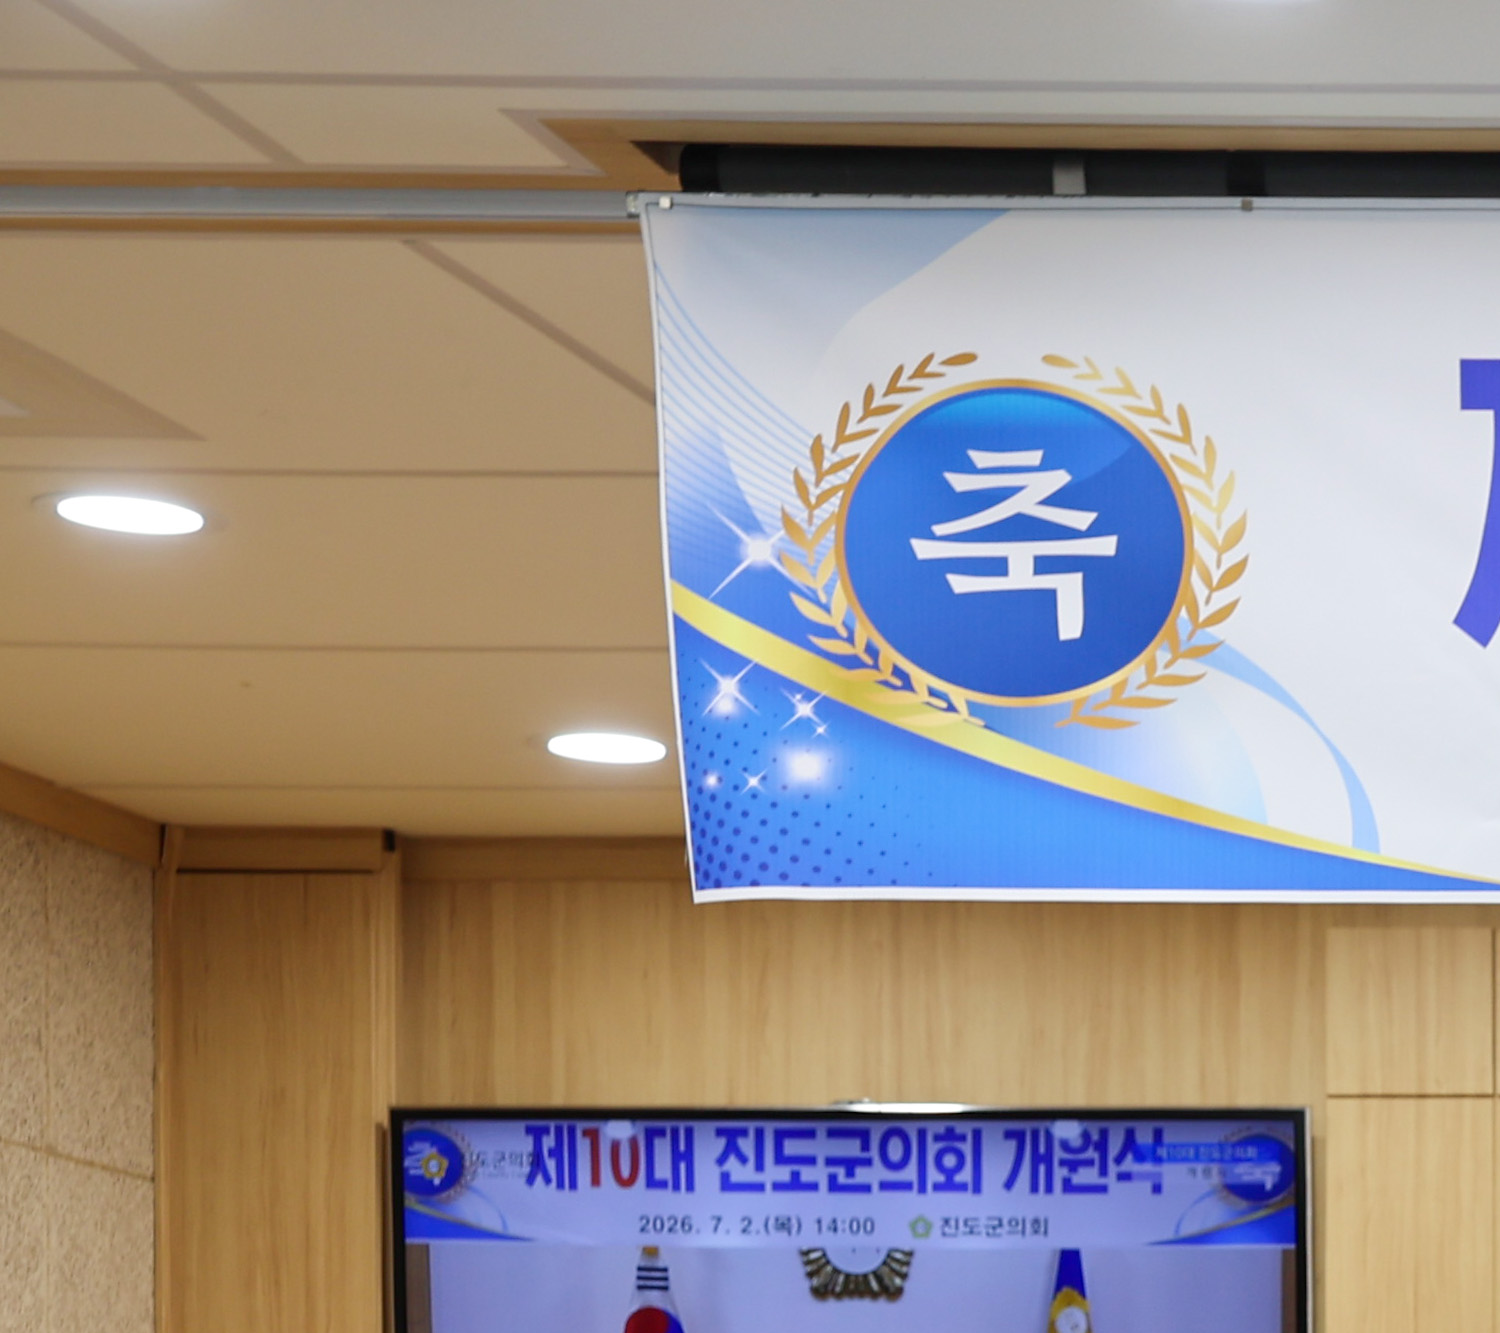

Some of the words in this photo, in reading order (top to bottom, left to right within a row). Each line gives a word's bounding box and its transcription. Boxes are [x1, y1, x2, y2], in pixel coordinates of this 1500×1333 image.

[909, 445, 1123, 643] 축
[522, 1124, 696, 1193] 제10대
[714, 1126, 982, 1195] 진도군의회
[1002, 1126, 1165, 1195] 개원식
[638, 1214, 702, 1238] 2026.
[711, 1215, 734, 1238] 7.
[813, 1215, 876, 1238] 14:00
[939, 1213, 1050, 1240] 진도군의회
